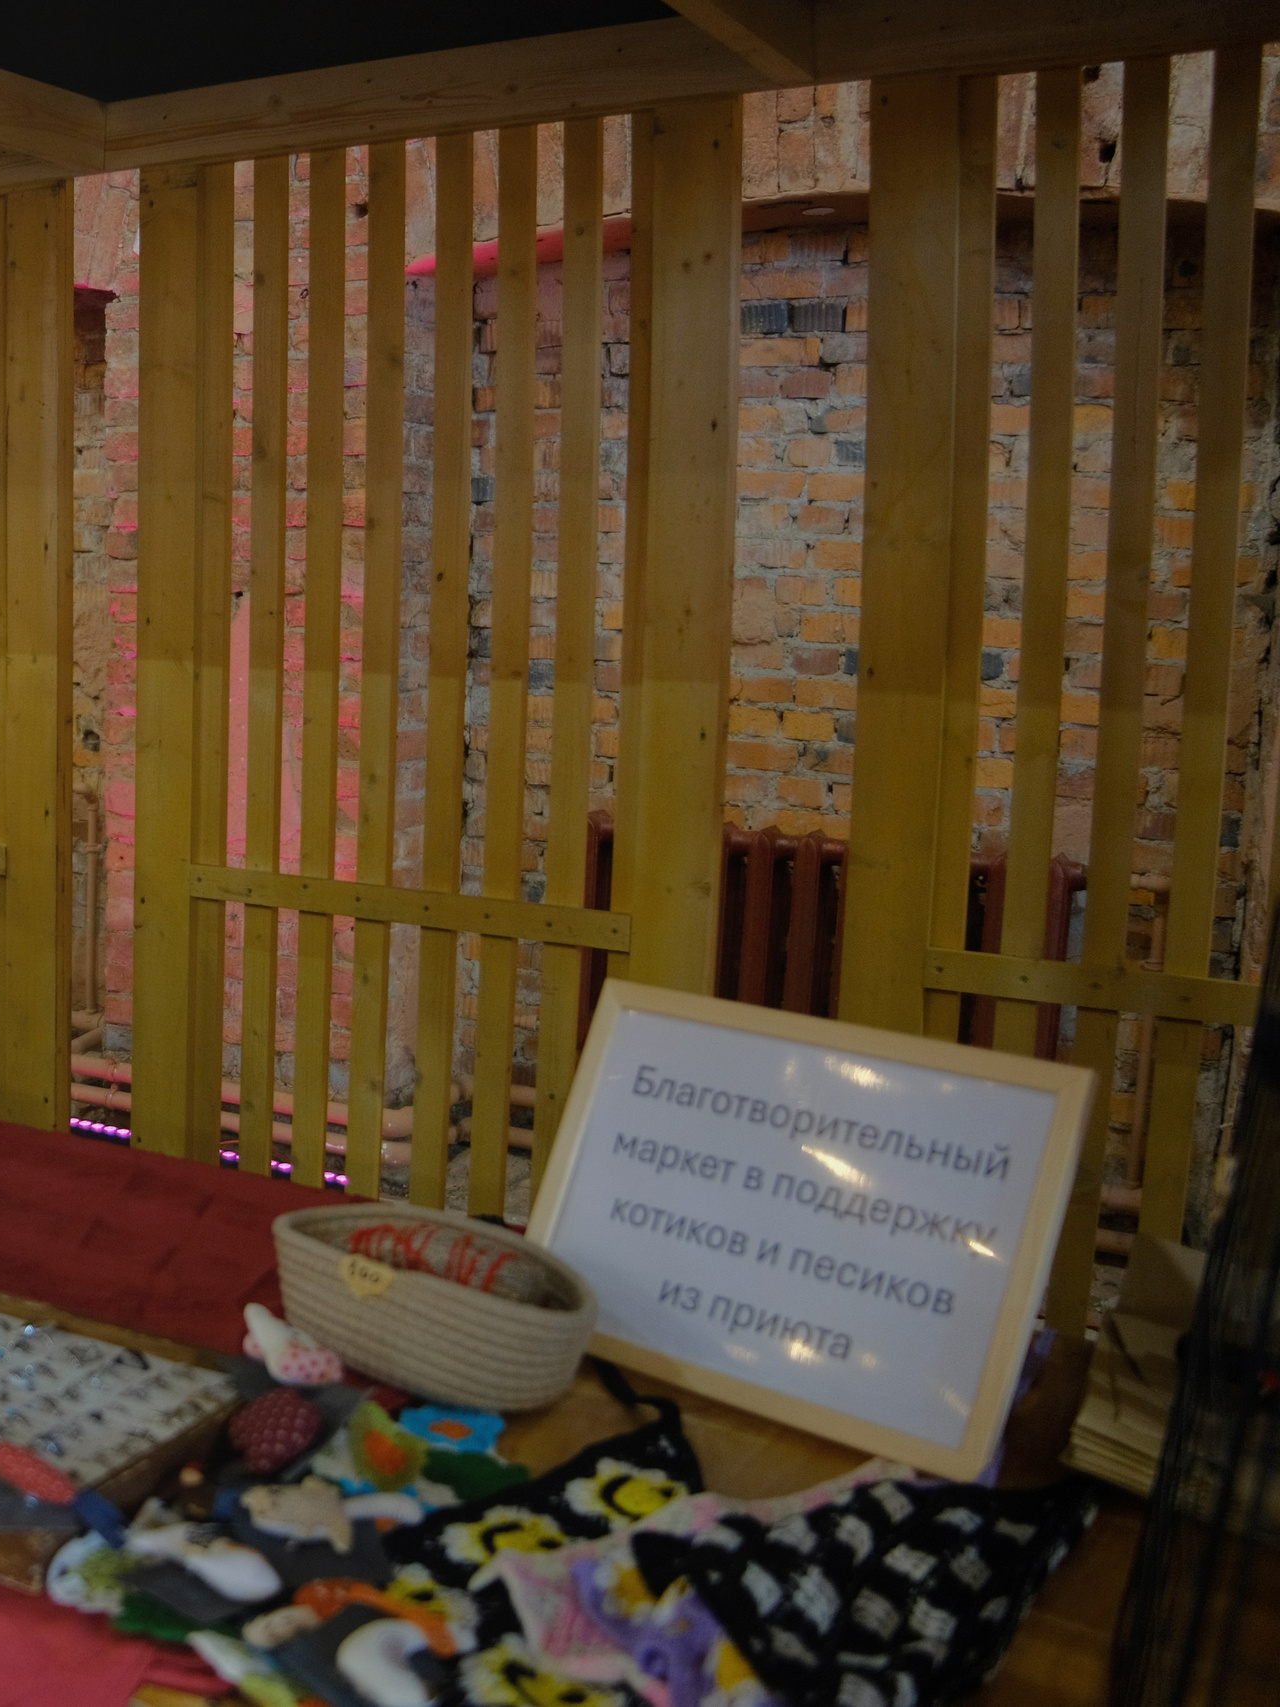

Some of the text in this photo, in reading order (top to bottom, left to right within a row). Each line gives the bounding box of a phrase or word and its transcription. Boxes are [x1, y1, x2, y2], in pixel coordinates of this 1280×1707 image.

[632, 1065, 1012, 1181] Благотворительный
[613, 1132, 999, 1257] маркет в поддержку
[610, 1197, 955, 1317] котиков и песиков
[658, 1279, 854, 1361] из приюта
